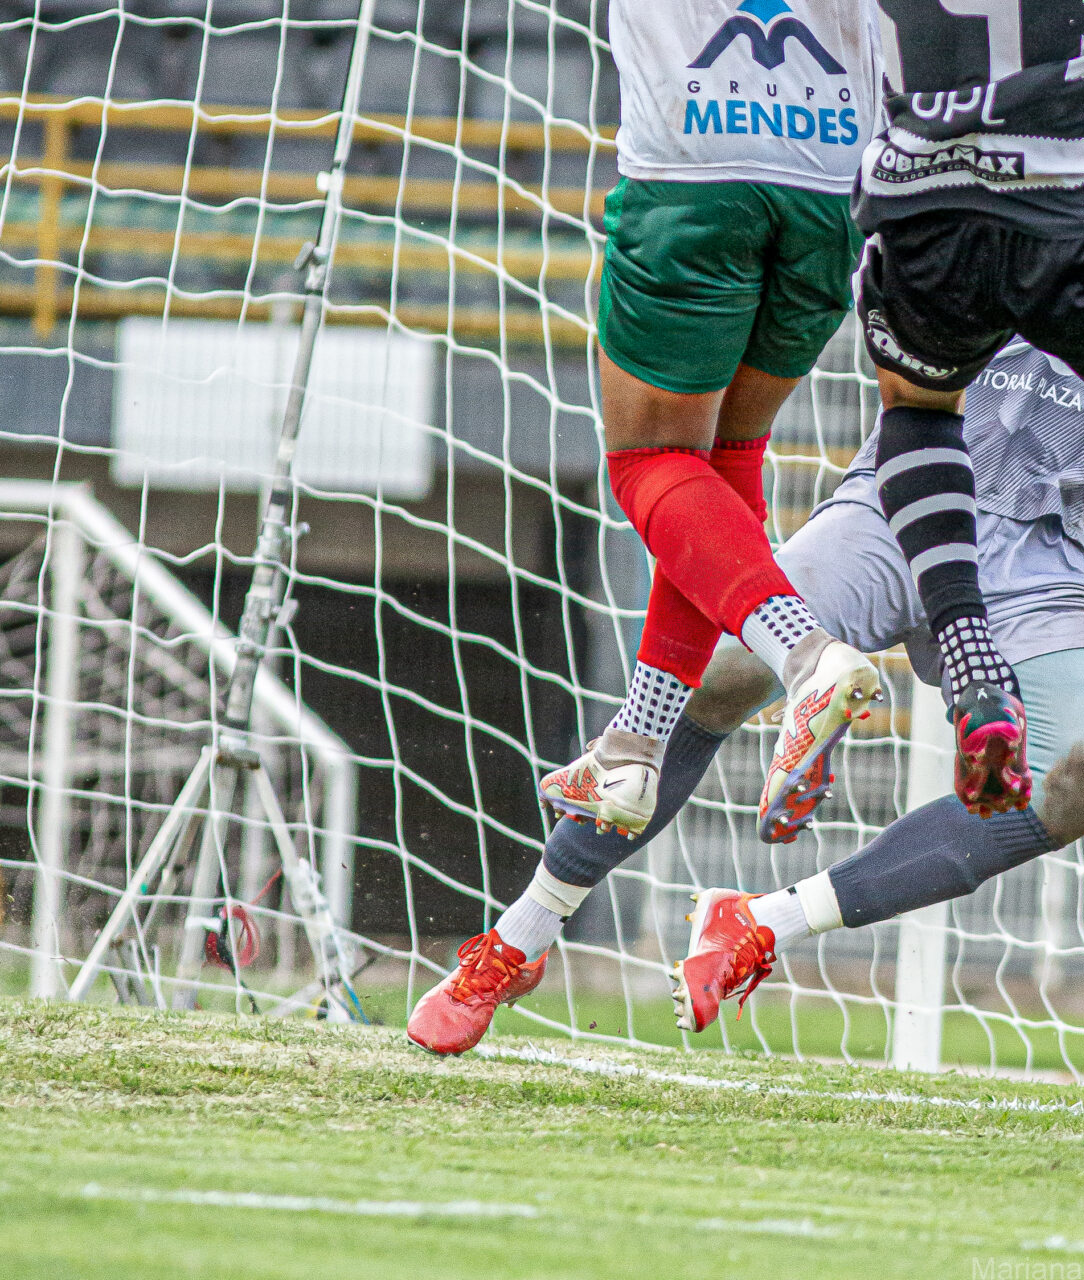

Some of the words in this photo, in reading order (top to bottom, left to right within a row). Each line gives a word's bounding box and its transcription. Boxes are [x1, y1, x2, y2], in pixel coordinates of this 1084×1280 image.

[687, 79, 852, 102] GRUPO
[683, 99, 859, 146] MENDES
[880, 146, 1018, 176] OBRAMAX
